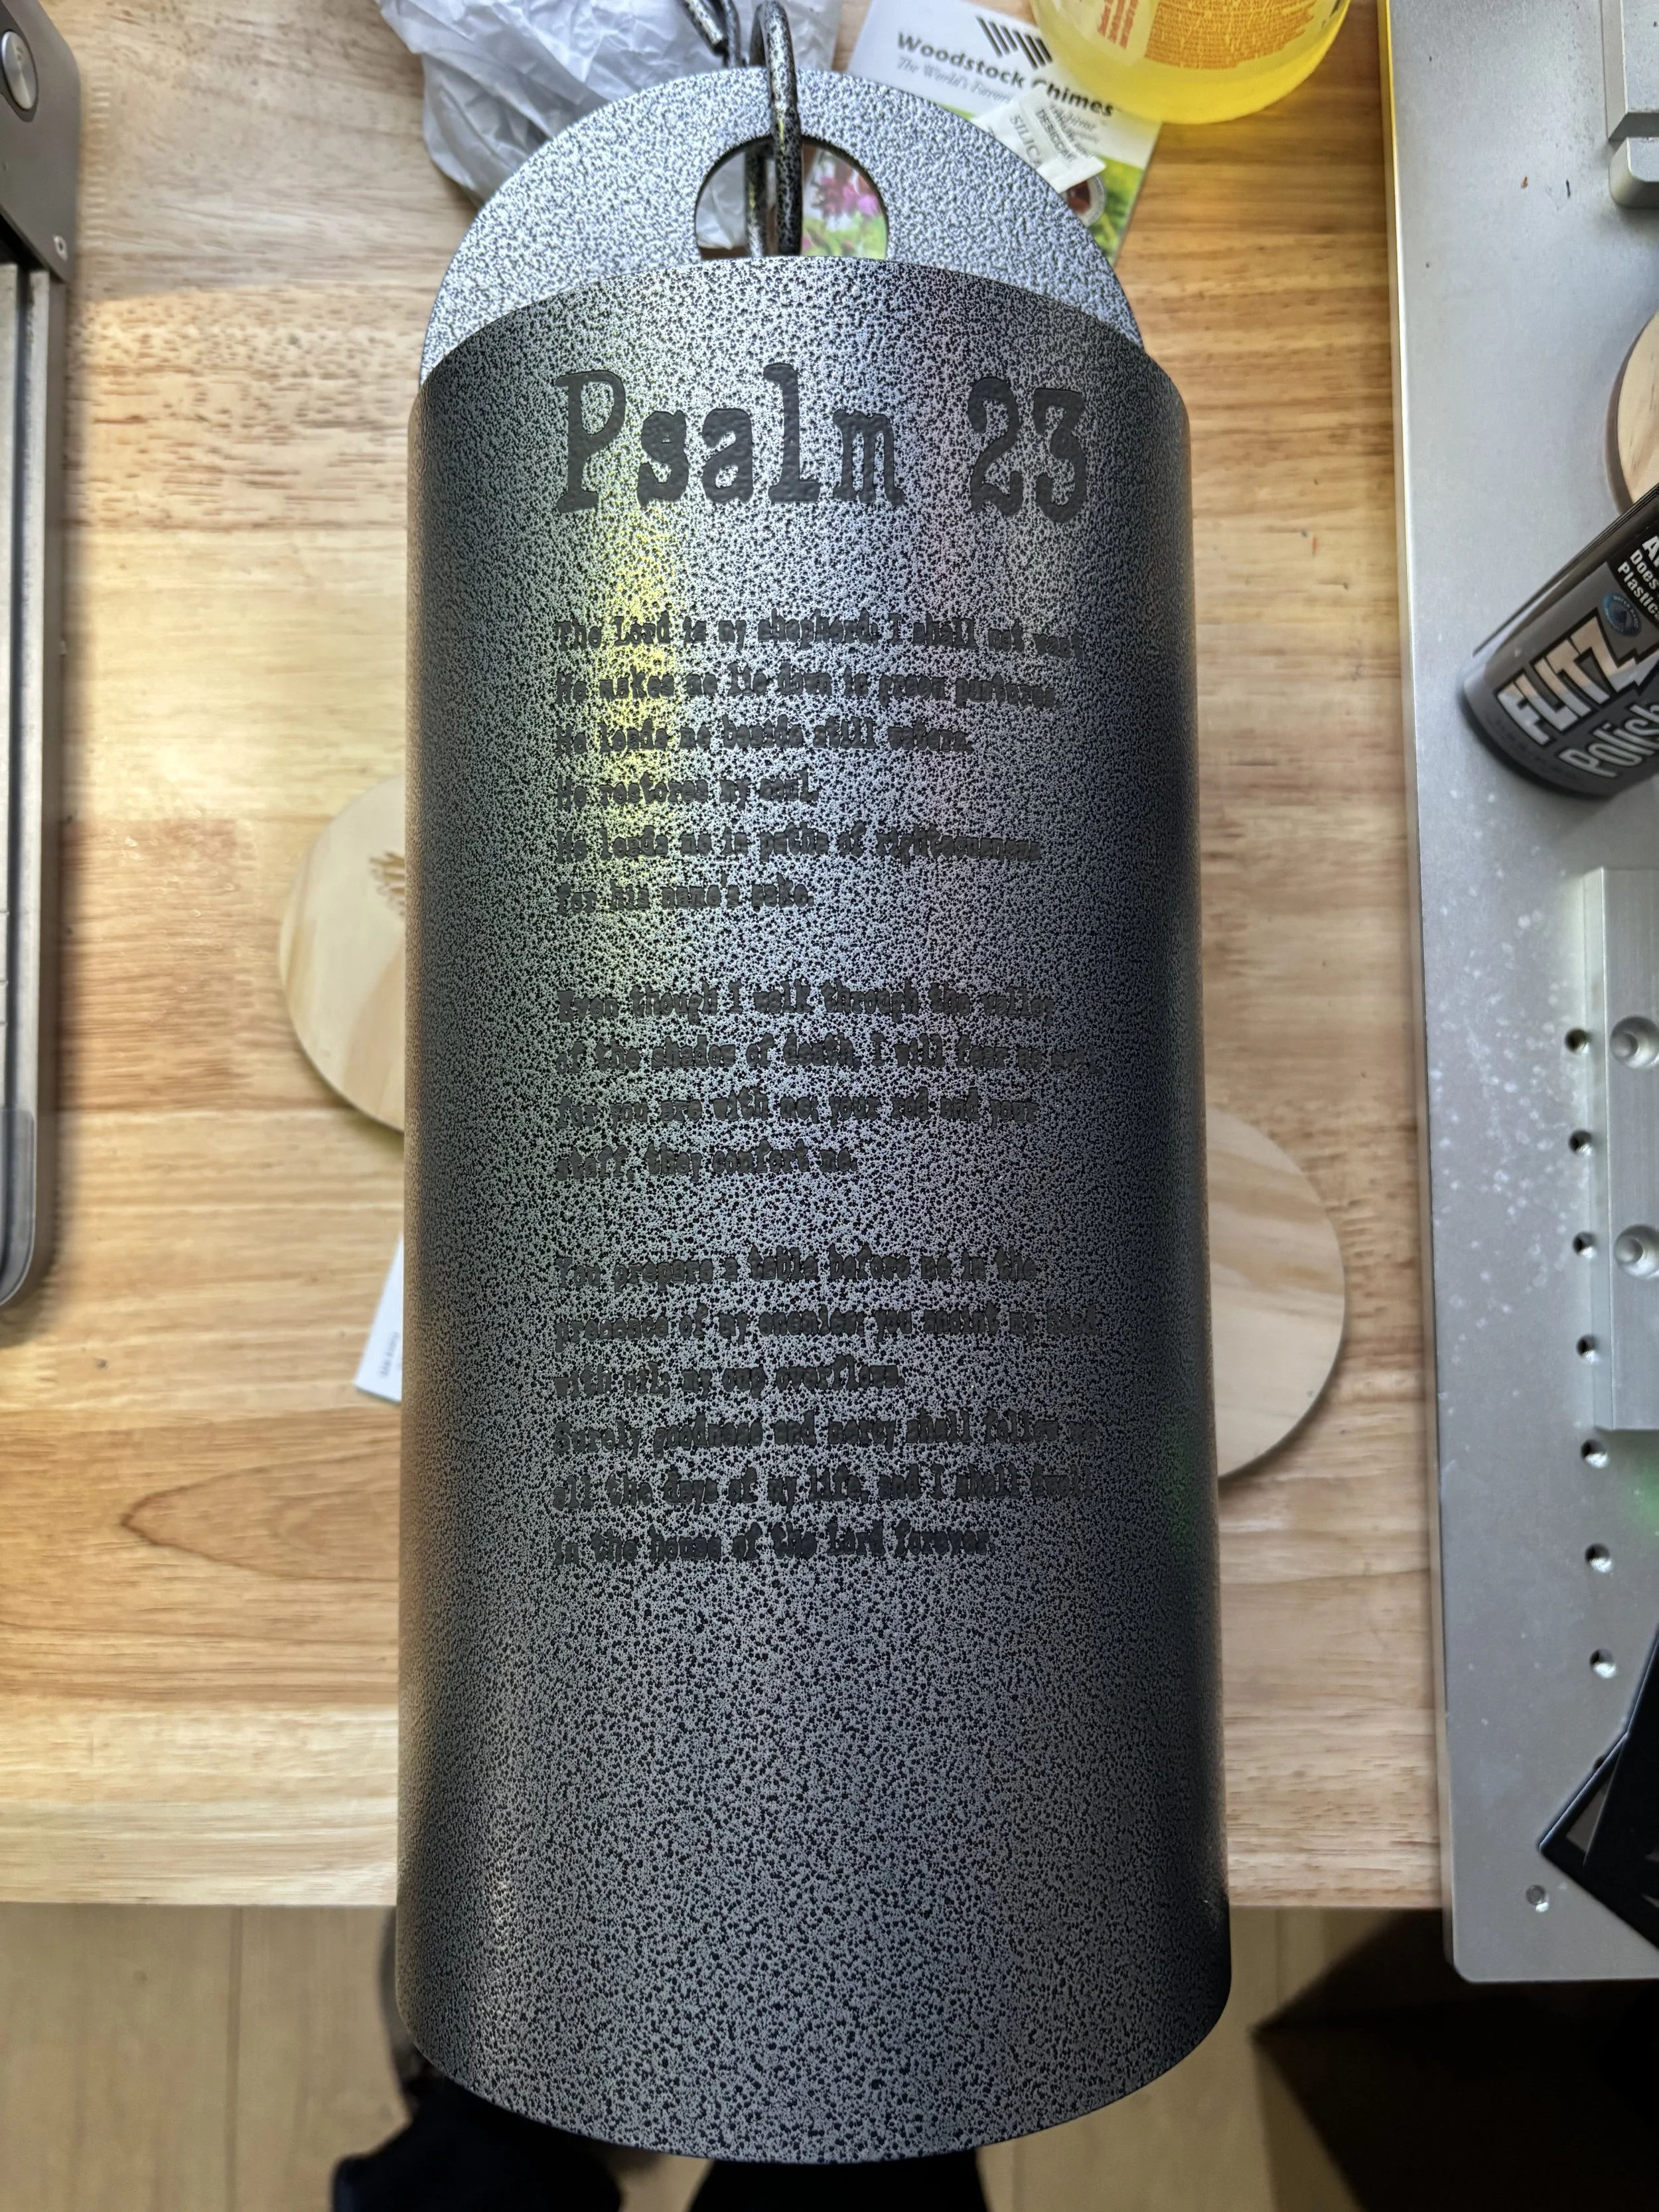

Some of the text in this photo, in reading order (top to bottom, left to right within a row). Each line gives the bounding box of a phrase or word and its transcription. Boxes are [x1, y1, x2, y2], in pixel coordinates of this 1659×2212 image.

[897, 31, 1026, 89] Woodstock
[555, 362, 1087, 523] Psalm 23
[1630, 549, 1659, 590] Does
[555, 617, 601, 649] The
[614, 613, 670, 646] Lord
[684, 617, 706, 643] is
[719, 619, 745, 649] my
[758, 610, 880, 648] shepherd;
[889, 613, 901, 645] I
[914, 617, 977, 649] shall
[988, 620, 1023, 651] not
[556, 671, 587, 704] He
[600, 668, 673, 699] makes
[686, 673, 717, 696] me
[729, 664, 767, 695] lie
[778, 664, 831, 695] down
[844, 668, 868, 697] in
[879, 673, 945, 707] green
[1496, 615, 1659, 746] FLITZ
[556, 724, 586, 756] He
[600, 719, 667, 752] leads
[680, 725, 710, 749] me
[723, 717, 802, 749] beside
[814, 718, 877, 749] still
[556, 764, 818, 811] He restores my soul.
[556, 830, 587, 863] He
[599, 825, 668, 860] leads
[680, 832, 711, 856] me
[723, 826, 748, 855] in
[759, 822, 829, 862] paths
[837, 823, 865, 855] of
[556, 871, 814, 915] for his name's sake.
[557, 979, 1054, 1025] Even though I walk through the valley
[556, 1040, 586, 1074] of
[595, 1037, 640, 1070] the
[651, 1034, 735, 1068] shadow
[747, 1032, 774, 1066] of
[871, 1031, 884, 1065] I
[895, 1034, 945, 1065] will
[956, 1034, 1008, 1067] fear
[1017, 1045, 1041, 1068] no
[556, 1096, 598, 1129] for
[609, 1101, 646, 1129] you
[662, 1099, 701, 1123] are
[711, 1086, 767, 1119] with
[829, 1096, 880, 1128] your
[891, 1087, 929, 1119] rod
[940, 1087, 979, 1120] and
[988, 1098, 1038, 1128] your
[556, 1138, 857, 1181] staff, they comfort me.
[555, 1244, 1037, 1292] You prepare a table before me in the
[554, 1313, 668, 1352] presence
[680, 1303, 708, 1340] of
[719, 1315, 749, 1343] my
[875, 1309, 912, 1341] you
[924, 1301, 999, 1335] anoint
[1009, 1313, 1036, 1342] my
[1046, 1301, 1096, 1335] head
[554, 1368, 611, 1398] with
[683, 1367, 711, 1398] my
[722, 1366, 764, 1398] cup
[553, 1408, 1098, 1458] Surely goodness and mercy shall follow me
[553, 1476, 593, 1510] all
[607, 1477, 652, 1505] the
[664, 1467, 719, 1513] days
[728, 1467, 758, 1503] of
[768, 1476, 796, 1512] my
[878, 1465, 920, 1499] and
[932, 1465, 945, 1499] I
[956, 1465, 1022, 1499] shall
[1031, 1465, 1096, 1499] dwell
[553, 1538, 579, 1566] in
[591, 1531, 637, 1562] the
[650, 1526, 721, 1562] house
[733, 1522, 762, 1560] of
[772, 1522, 816, 1557] the
[828, 1519, 883, 1556] Lord
